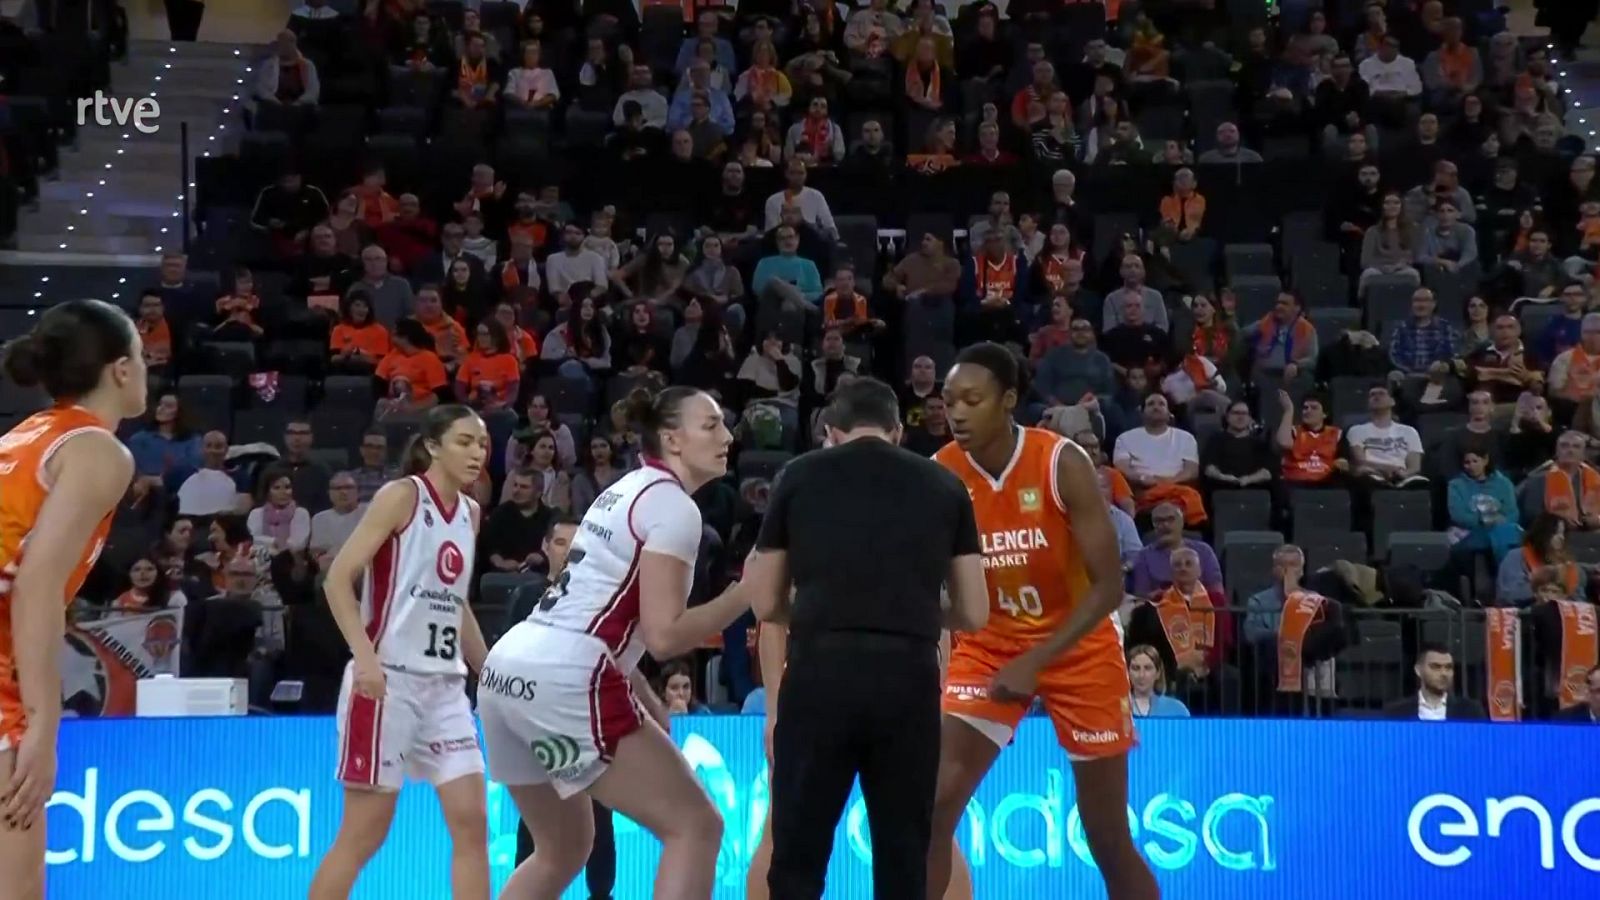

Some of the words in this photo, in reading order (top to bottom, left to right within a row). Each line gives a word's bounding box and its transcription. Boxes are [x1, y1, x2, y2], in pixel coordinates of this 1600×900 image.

[980, 527, 1049, 554] LENCIA
[980, 552, 1028, 568] BASKET
[997, 586, 1043, 617] 40
[424, 622, 457, 660] 13
[480, 666, 537, 701] OMMOS
[44, 767, 312, 865] desa
